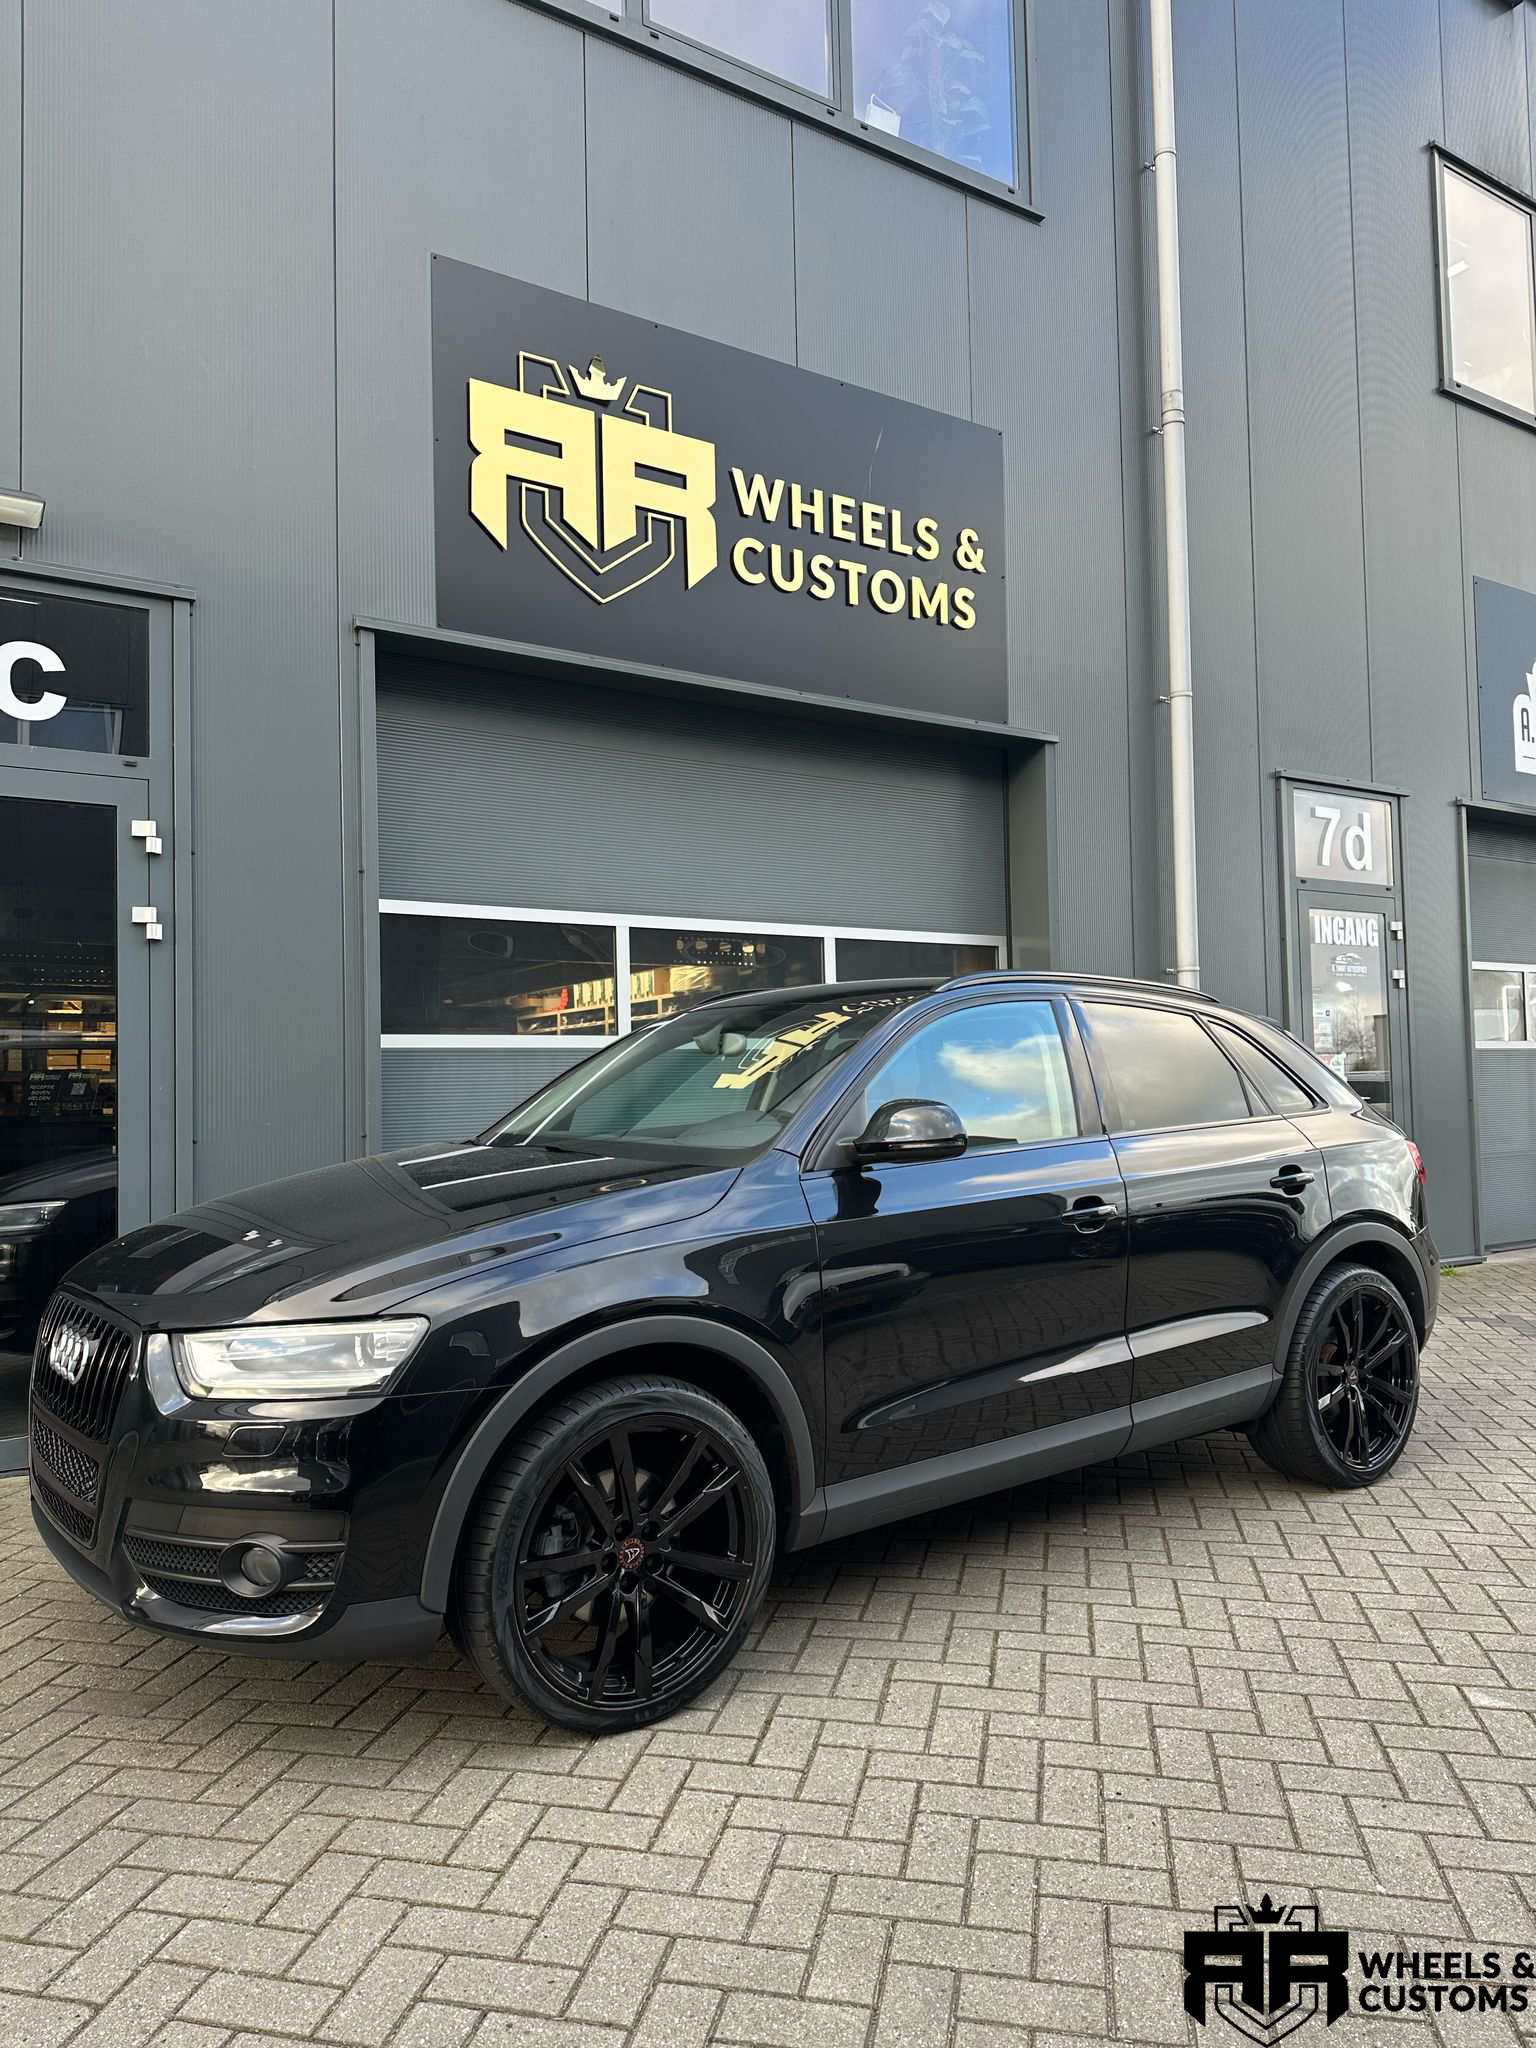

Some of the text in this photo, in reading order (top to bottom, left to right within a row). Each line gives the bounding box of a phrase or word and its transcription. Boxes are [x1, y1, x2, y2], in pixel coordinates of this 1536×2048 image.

[731, 467, 987, 573] WHEELS &
[732, 536, 978, 630] CUSTOMS
[1310, 805, 1373, 871] 7d
[1314, 914, 1379, 948] INGANG
